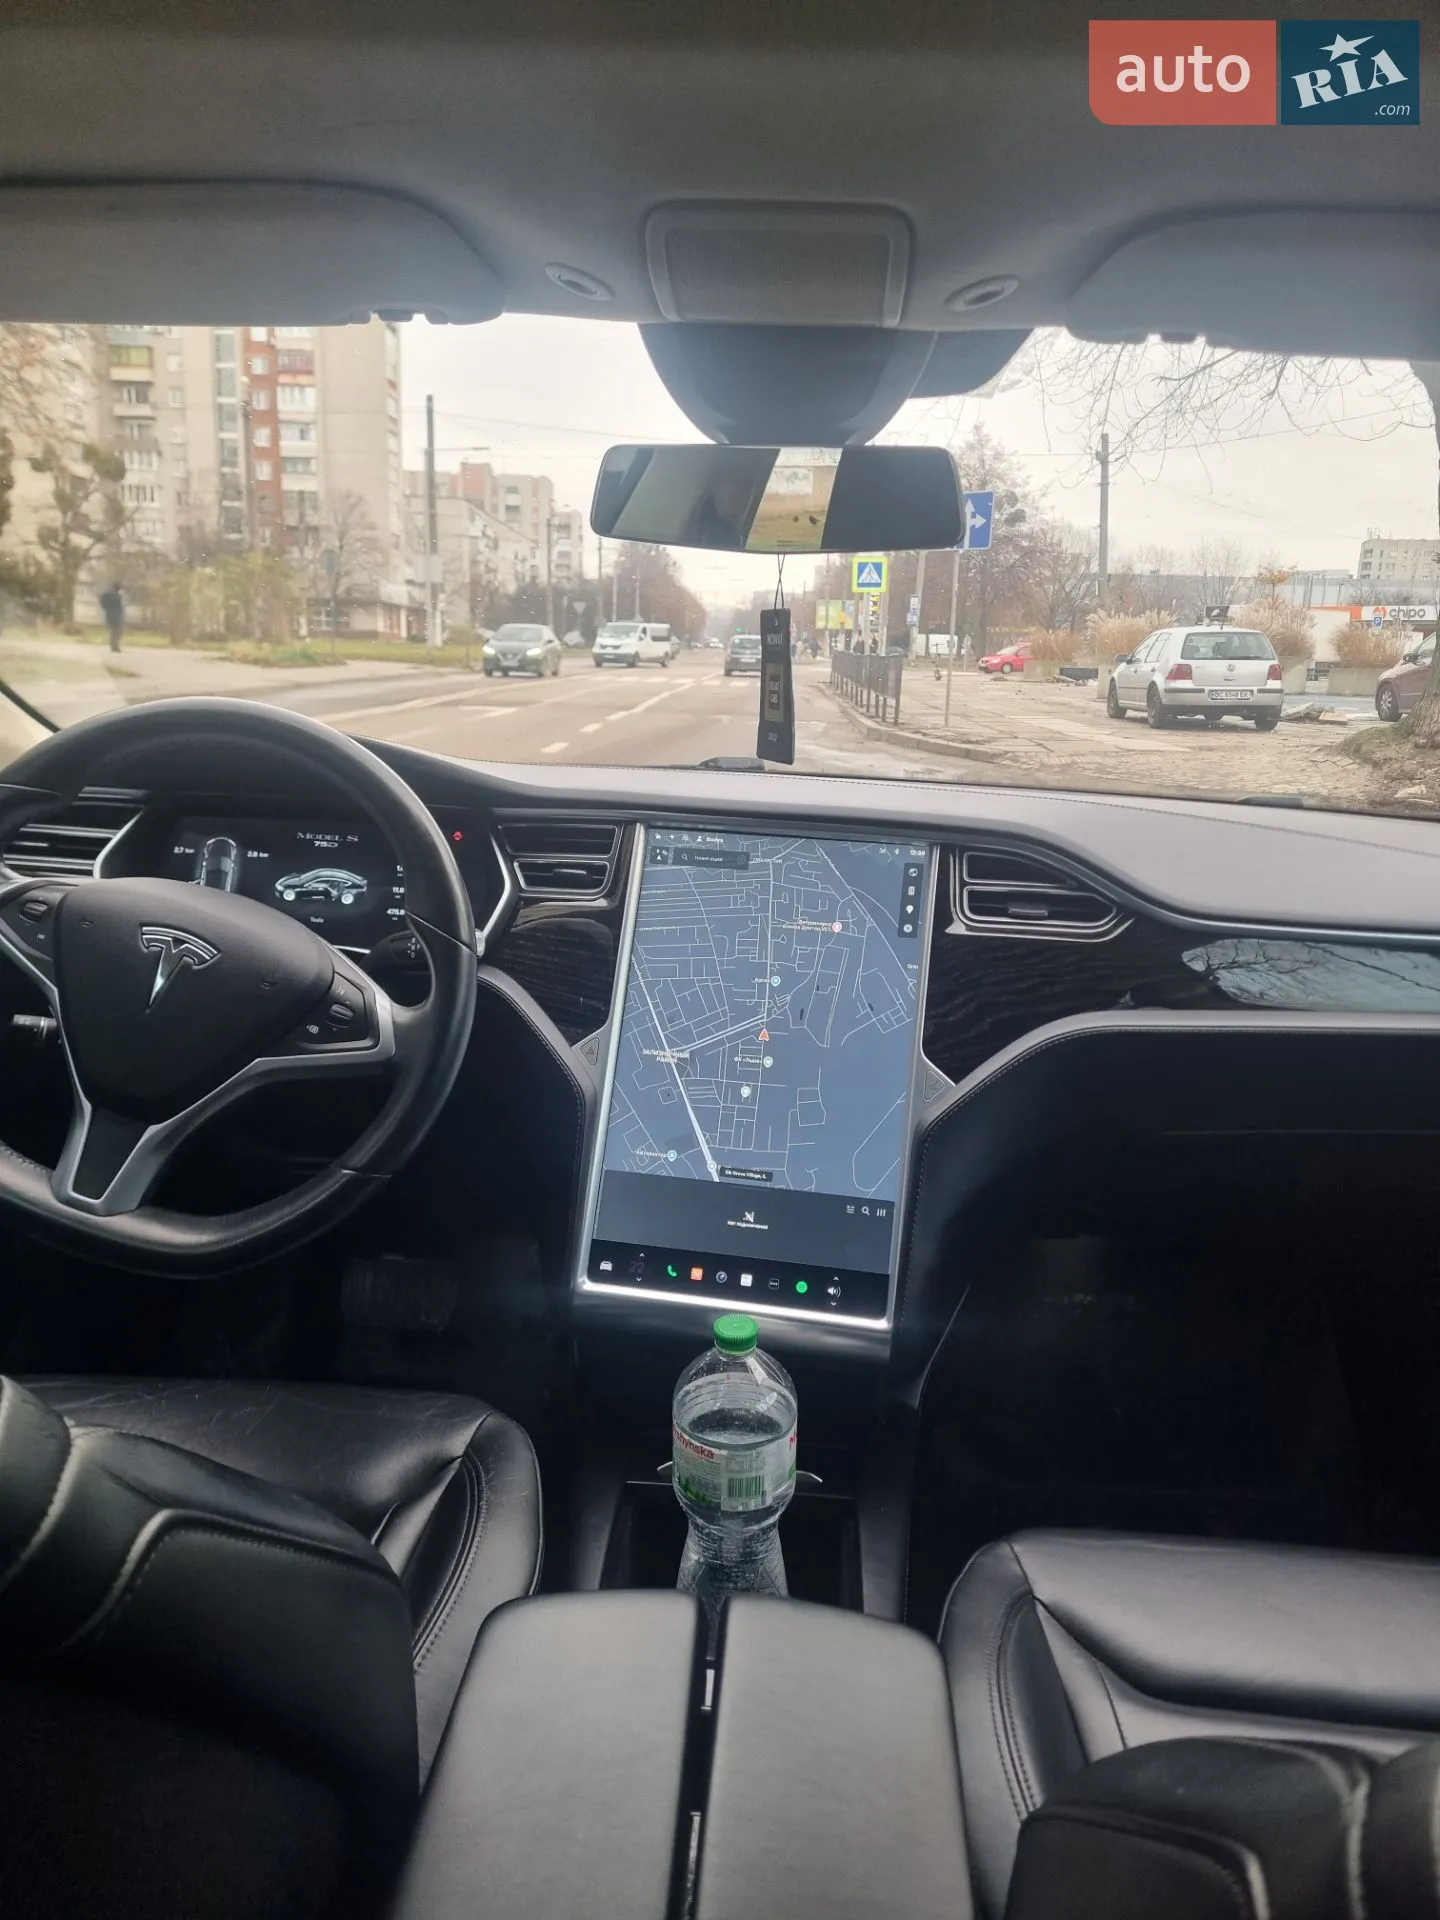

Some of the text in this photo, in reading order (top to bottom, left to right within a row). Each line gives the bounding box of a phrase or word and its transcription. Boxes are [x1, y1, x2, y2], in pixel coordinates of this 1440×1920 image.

[1389, 606, 1426, 621] chipo
[296, 832, 343, 842] MODEL
[313, 840, 338, 848] 75D
